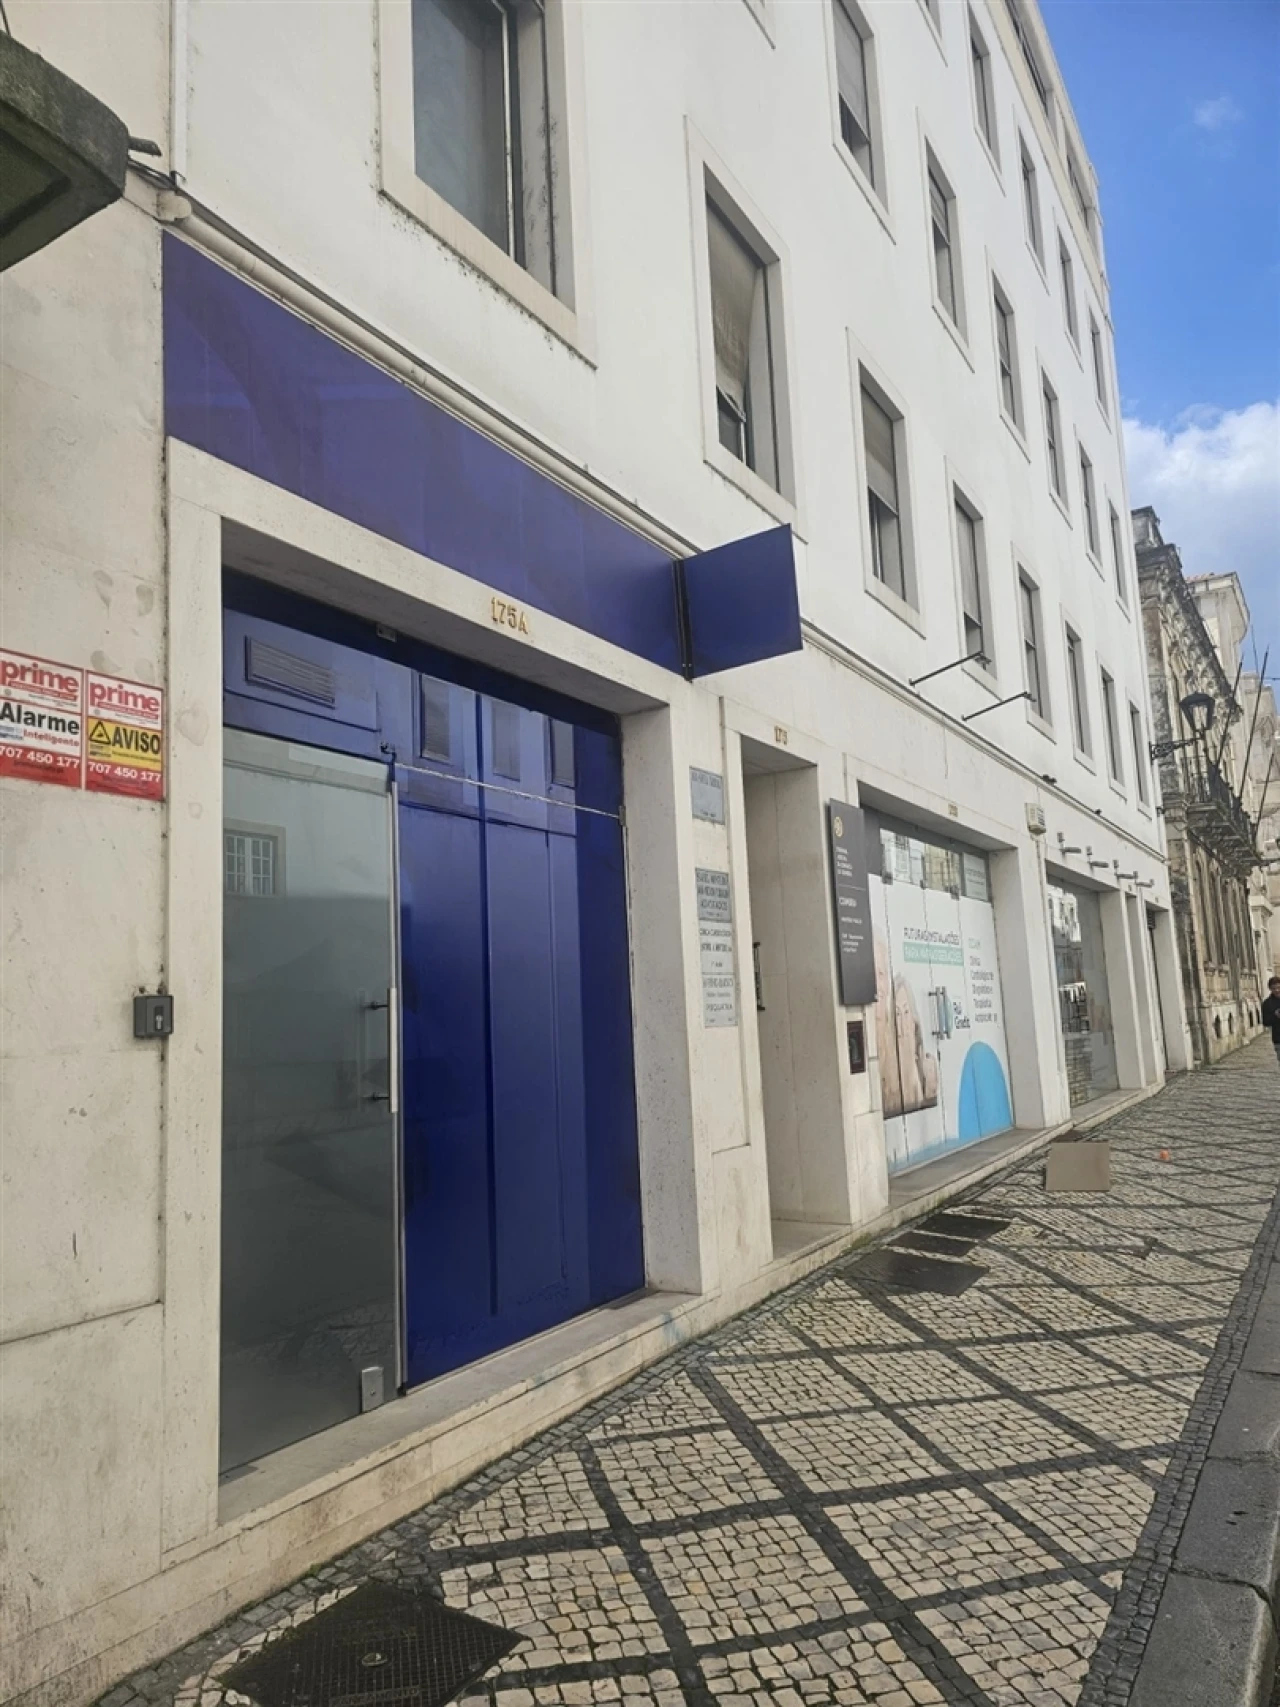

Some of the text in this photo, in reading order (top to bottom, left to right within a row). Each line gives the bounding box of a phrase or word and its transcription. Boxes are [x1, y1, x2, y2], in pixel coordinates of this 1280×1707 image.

[491, 597, 528, 634] 175A
[0, 660, 79, 693] prime
[90, 683, 159, 711] prime
[0, 702, 79, 735] Alarme
[23, 728, 80, 747] Inteligente
[112, 726, 161, 754] AVISO
[0, 746, 23, 758] 707
[27, 751, 53, 764] 450
[56, 757, 80, 769] 177
[89, 762, 111, 773] 707
[114, 767, 138, 779] 450
[140, 771, 161, 783] 177
